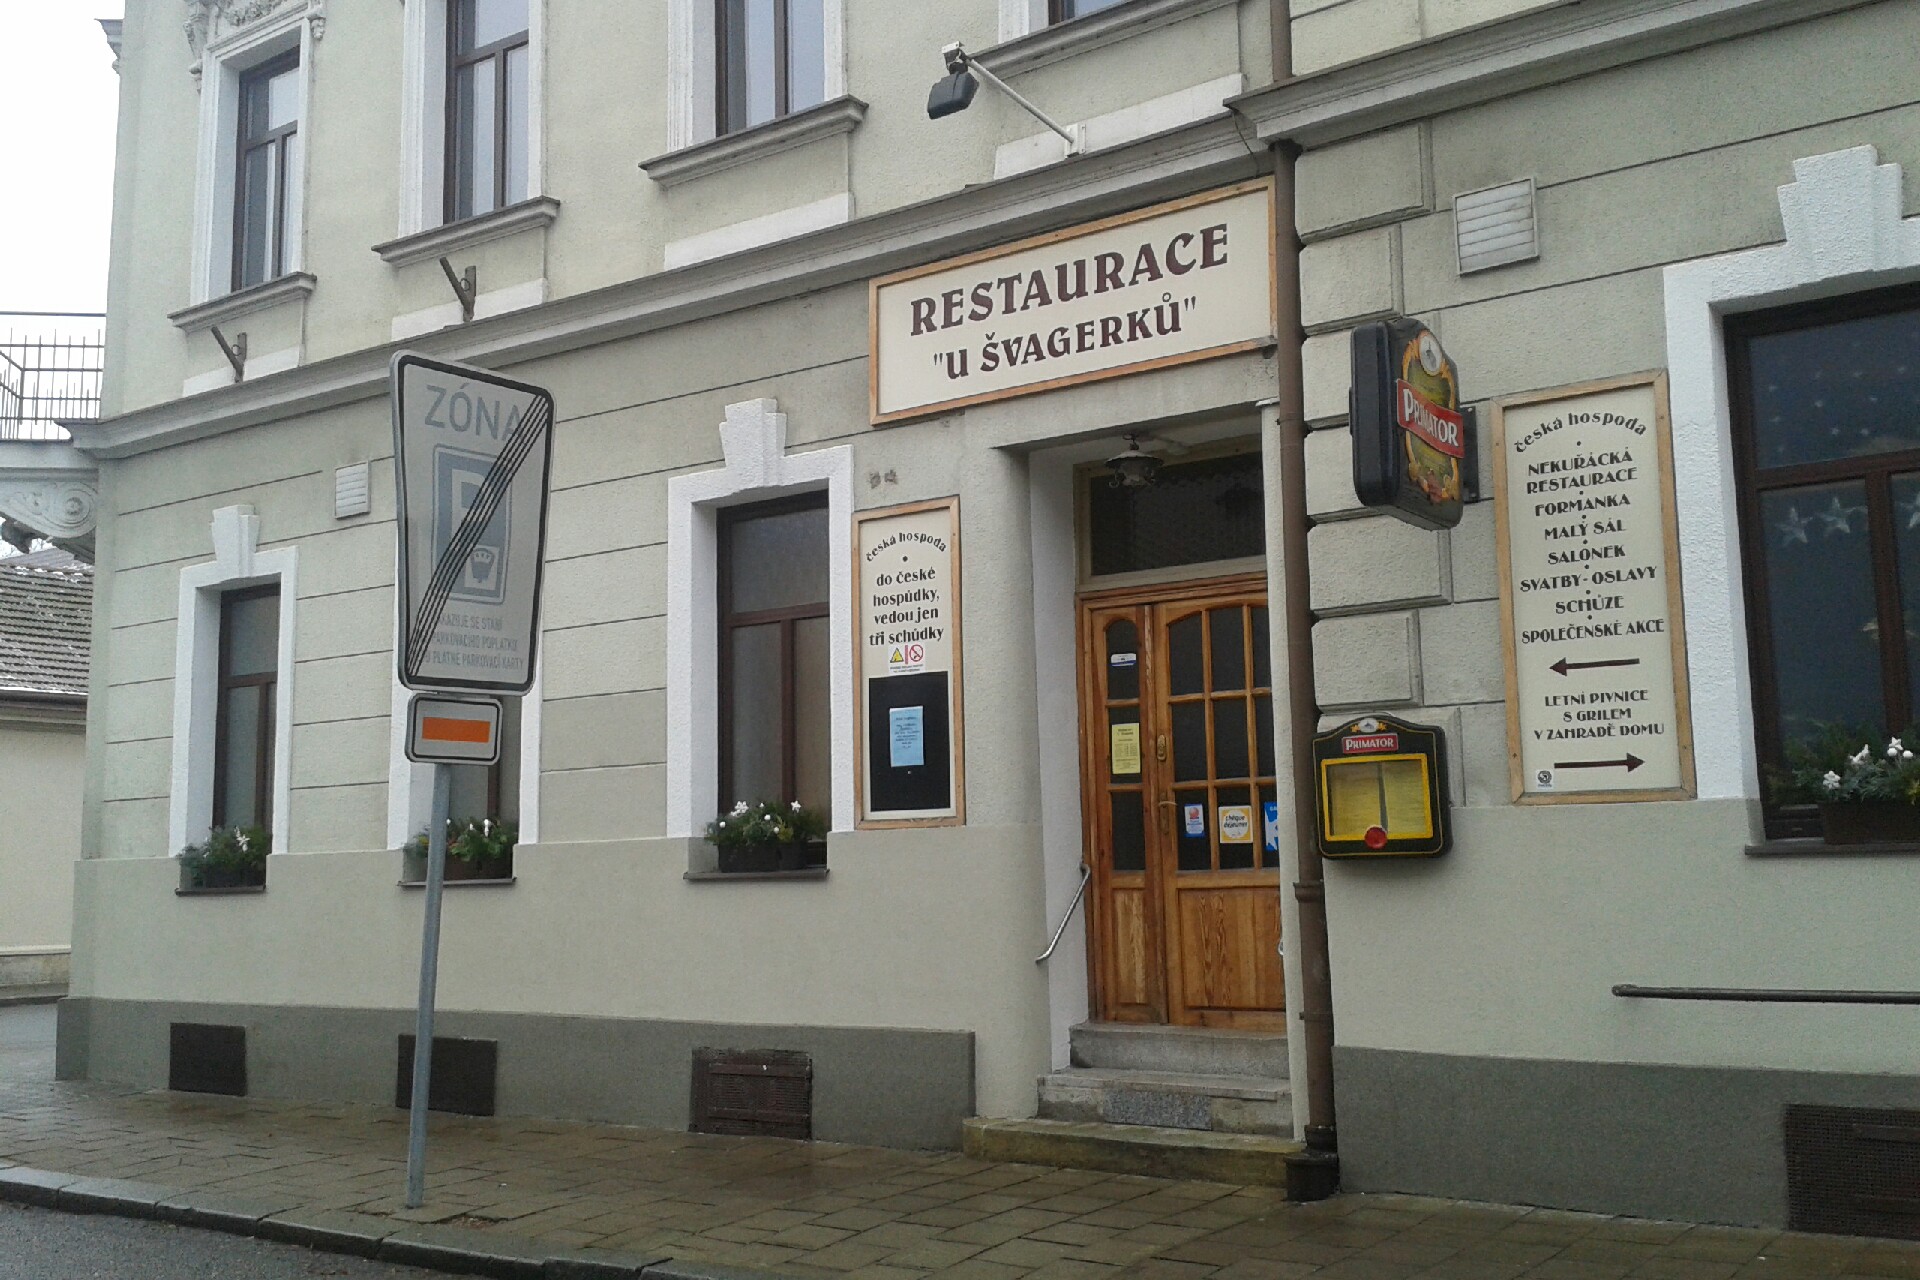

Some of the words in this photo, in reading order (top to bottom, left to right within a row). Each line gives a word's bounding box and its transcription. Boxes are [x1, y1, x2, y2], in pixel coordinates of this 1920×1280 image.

[910, 223, 1229, 336] RESTAURACE
[933, 348, 969, 380] "U
[979, 292, 1196, 372] ŠVAGERKŮ"
[425, 382, 526, 440] ZÓNA
[1514, 417, 1563, 453] česká
[1568, 412, 1647, 436] hospoda
[1528, 446, 1633, 477] NEKUŘÁCKÁ
[1526, 466, 1638, 494] RESTAURACE
[1534, 493, 1631, 517] FORMANKA
[1544, 520, 1588, 541] MALÝ
[1593, 517, 1627, 534] SÁL
[866, 535, 897, 562] česká
[898, 532, 946, 552] hospoda
[1547, 544, 1626, 565] SALONEK
[876, 572, 893, 587] do
[896, 566, 936, 585] české
[1592, 566, 1657, 585] OSLAVY
[874, 610, 914, 624] vedou
[915, 607, 939, 624] jen
[869, 631, 885, 646] tři
[1521, 619, 1622, 644] SPOLEČENSKÉ
[1626, 619, 1665, 634] AKCE
[1544, 691, 1586, 707] LETNÍ
[1589, 689, 1649, 703] PIVNICE
[1563, 712, 1572, 722] S
[1576, 708, 1632, 721] GRILEM
[1546, 723, 1616, 740] ZAHRADĚ
[1619, 723, 1665, 735] DOMU
[1345, 737, 1394, 751] PRIMATOR
